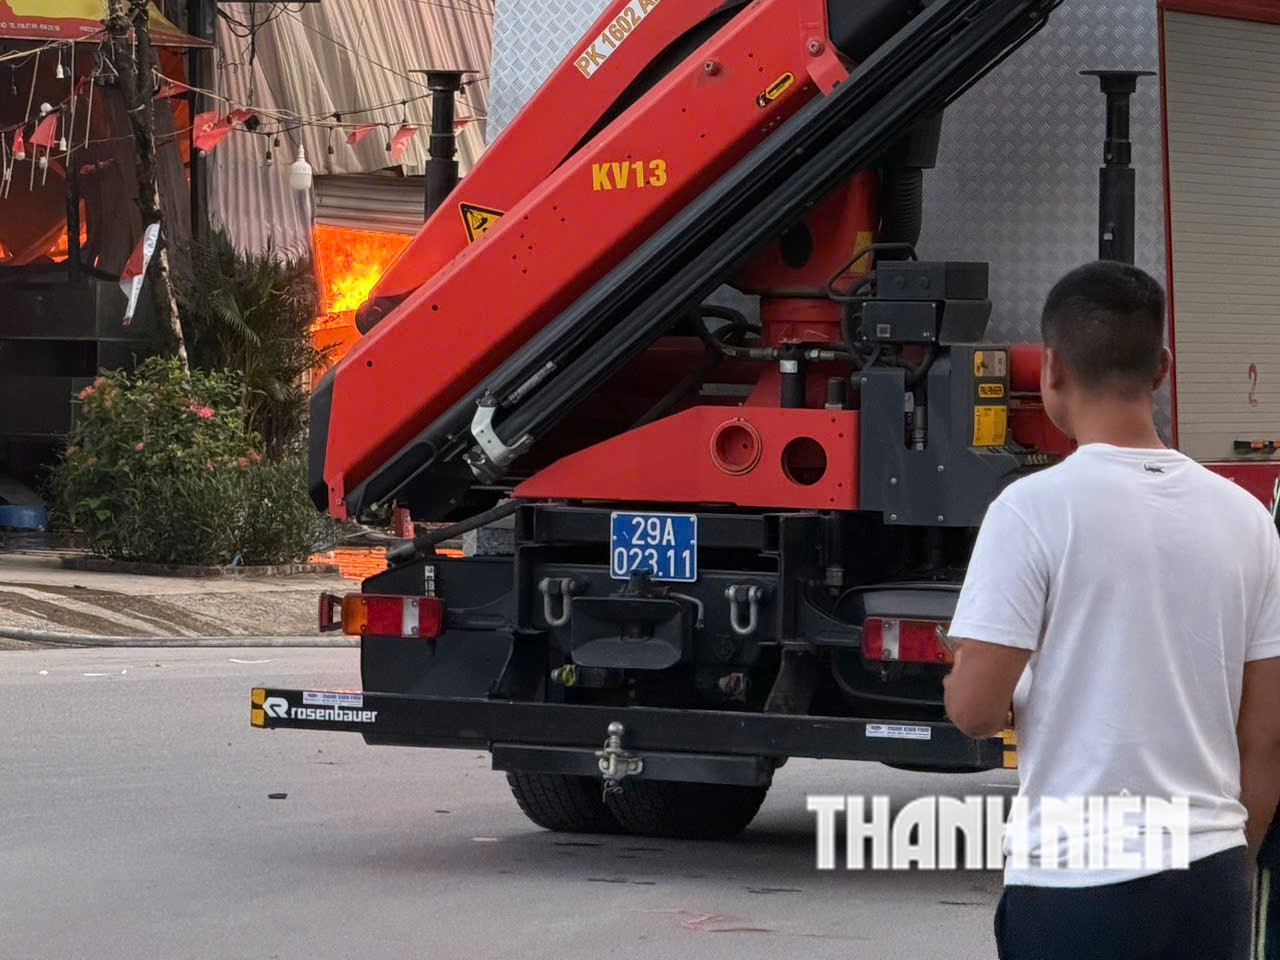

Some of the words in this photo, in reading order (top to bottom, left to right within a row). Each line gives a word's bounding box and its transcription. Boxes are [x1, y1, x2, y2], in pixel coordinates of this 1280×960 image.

[575, 43, 607, 76] PK
[601, 6, 642, 49] 1602
[592, 159, 667, 191] KV13
[631, 517, 675, 546] 29A
[614, 547, 691, 577] 023.11
[291, 704, 378, 722] rosenbauer
